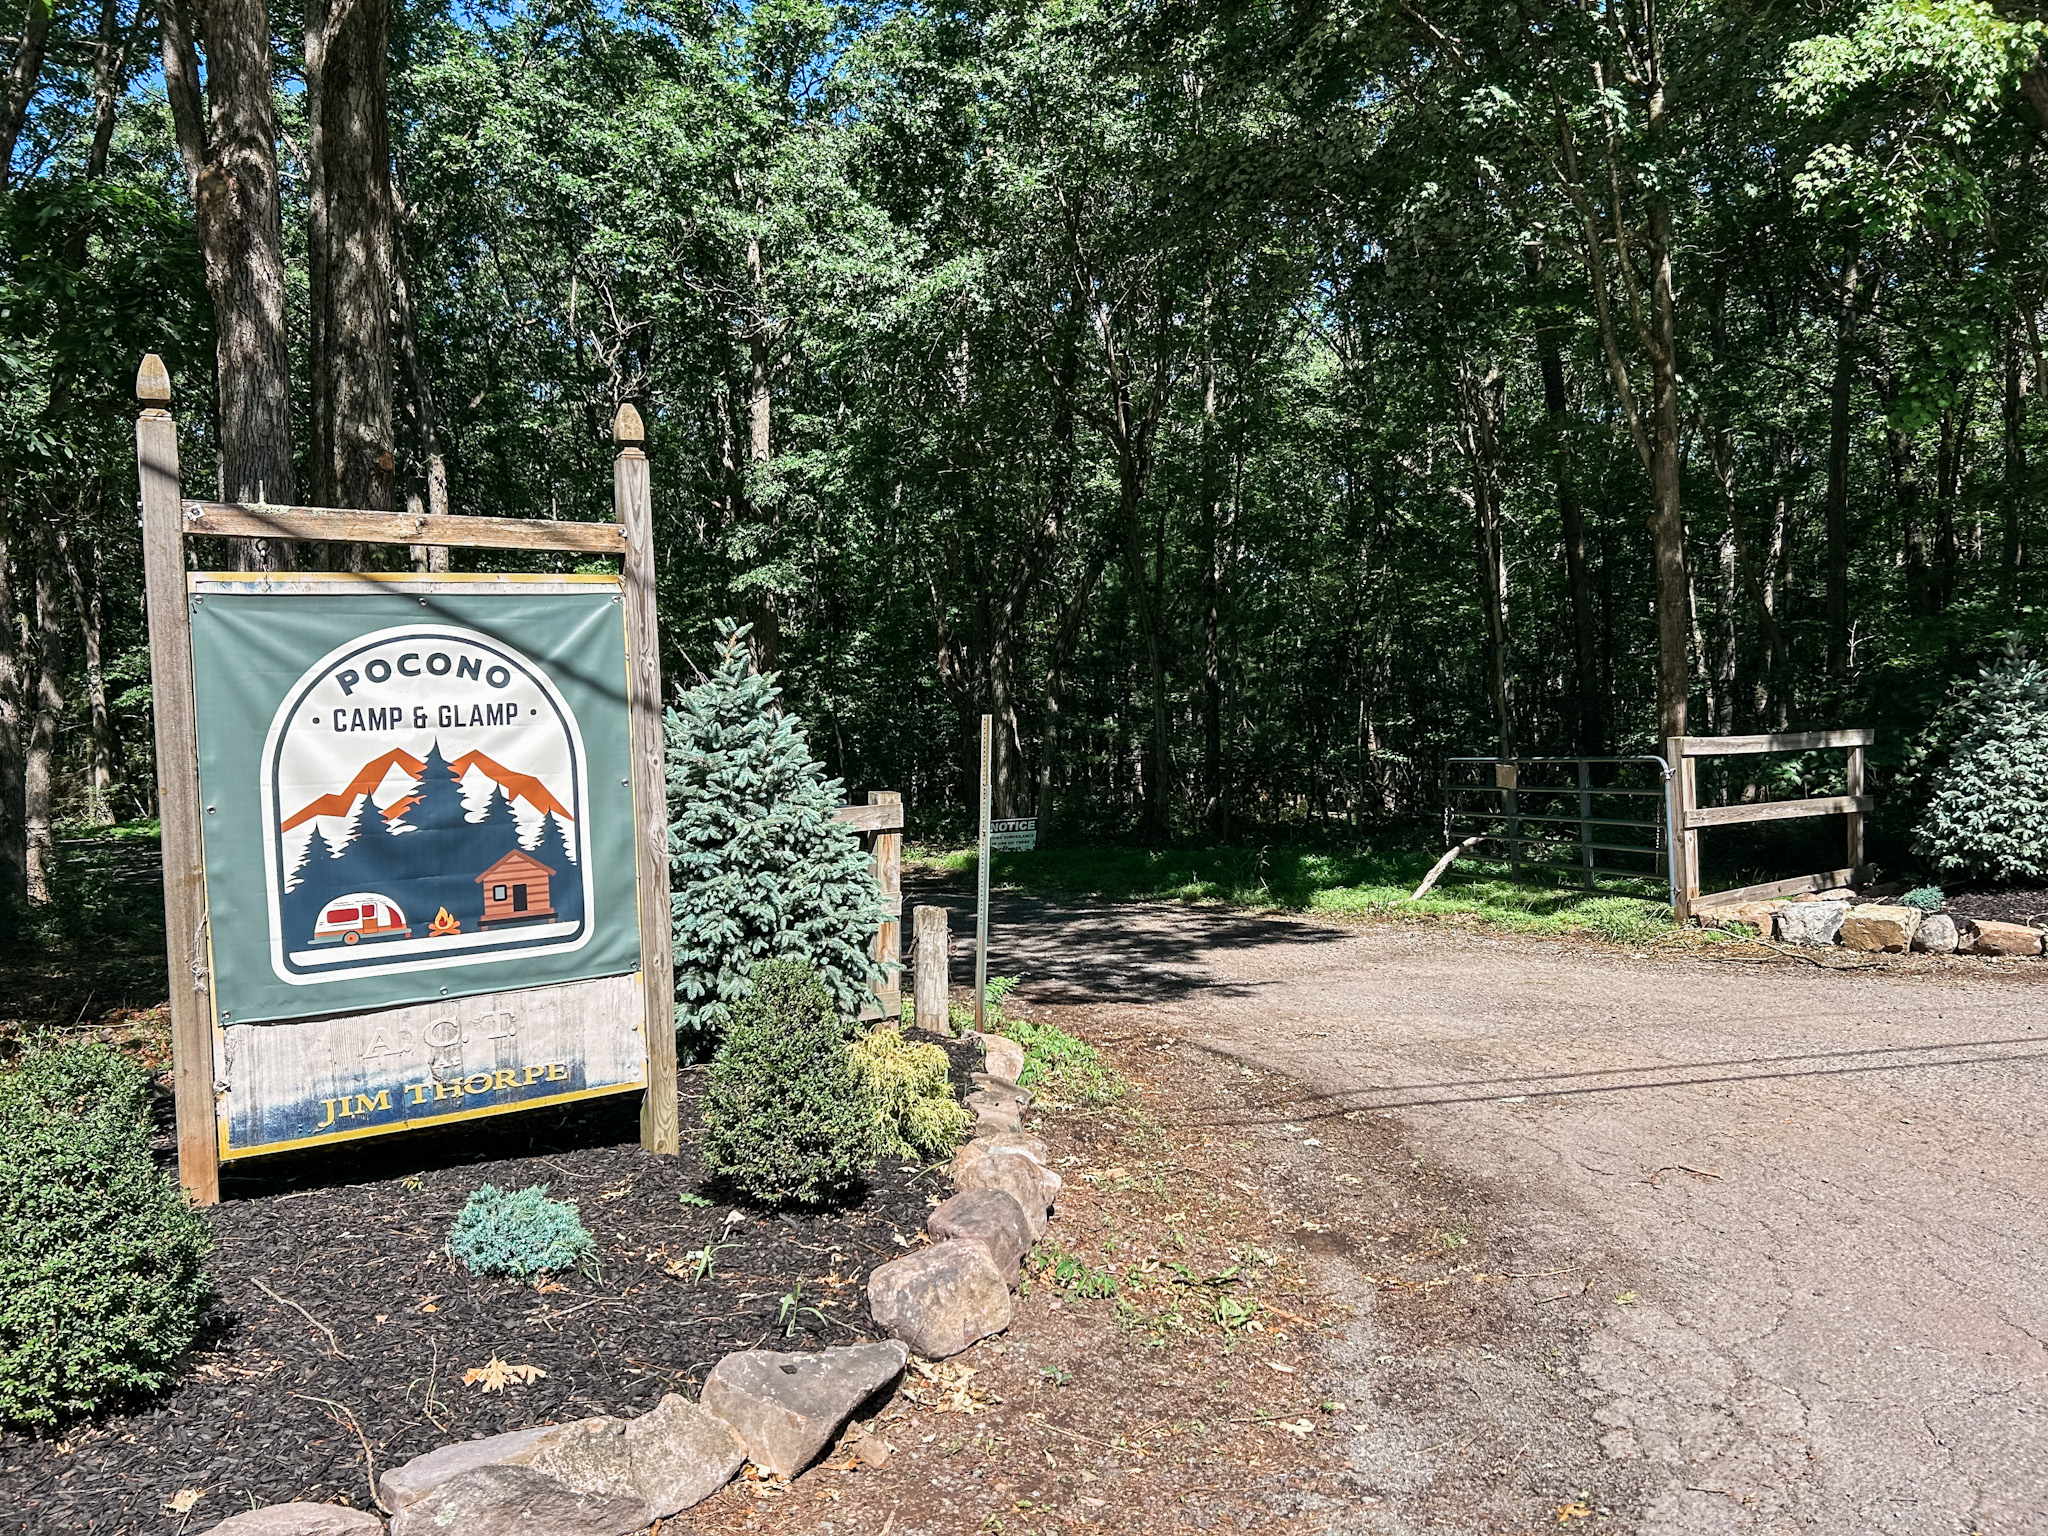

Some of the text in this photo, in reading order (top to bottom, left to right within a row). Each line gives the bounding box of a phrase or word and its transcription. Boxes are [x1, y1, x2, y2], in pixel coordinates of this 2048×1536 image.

[335, 652, 511, 696] POCONO
[333, 702, 518, 732] CAMP & GLAMP
[990, 820, 1035, 832] NOTICE
[317, 1062, 569, 1129] JIM THORPE
